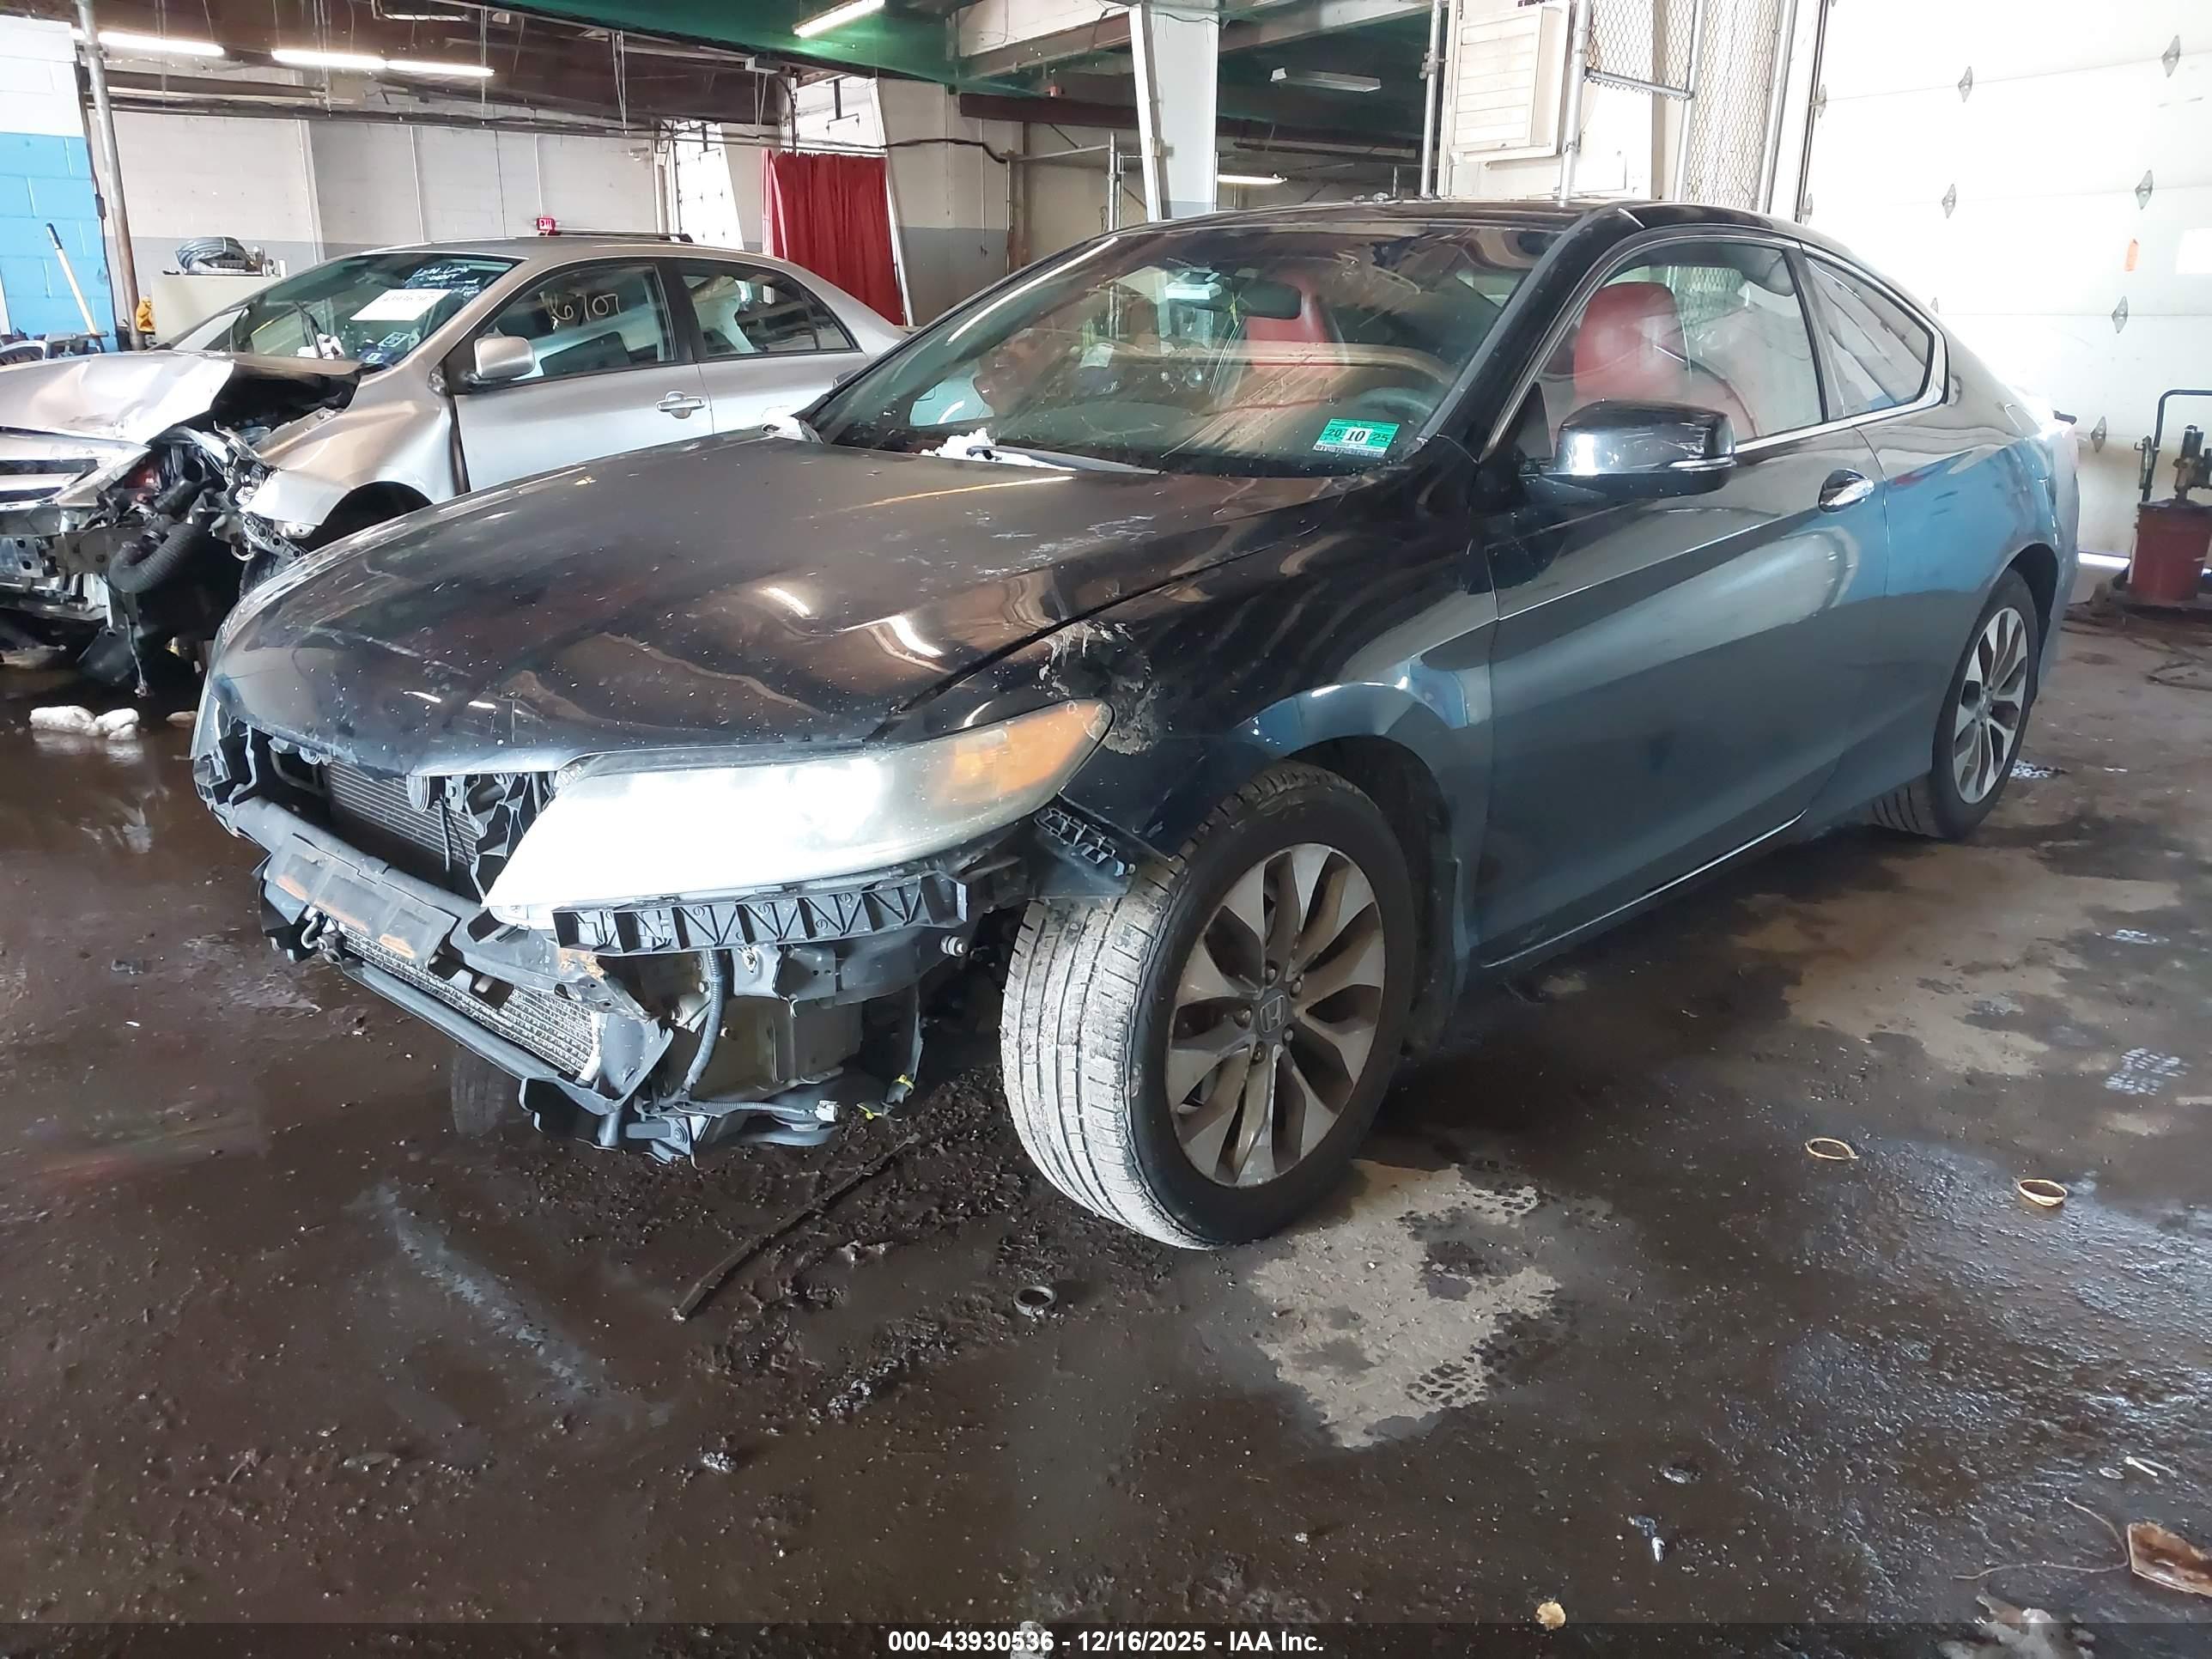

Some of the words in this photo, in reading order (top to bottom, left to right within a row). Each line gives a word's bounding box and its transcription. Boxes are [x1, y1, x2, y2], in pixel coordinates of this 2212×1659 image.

[1327, 428, 1343, 438] 20
[1346, 430, 1366, 442] 10
[1371, 433, 1389, 442] 25
